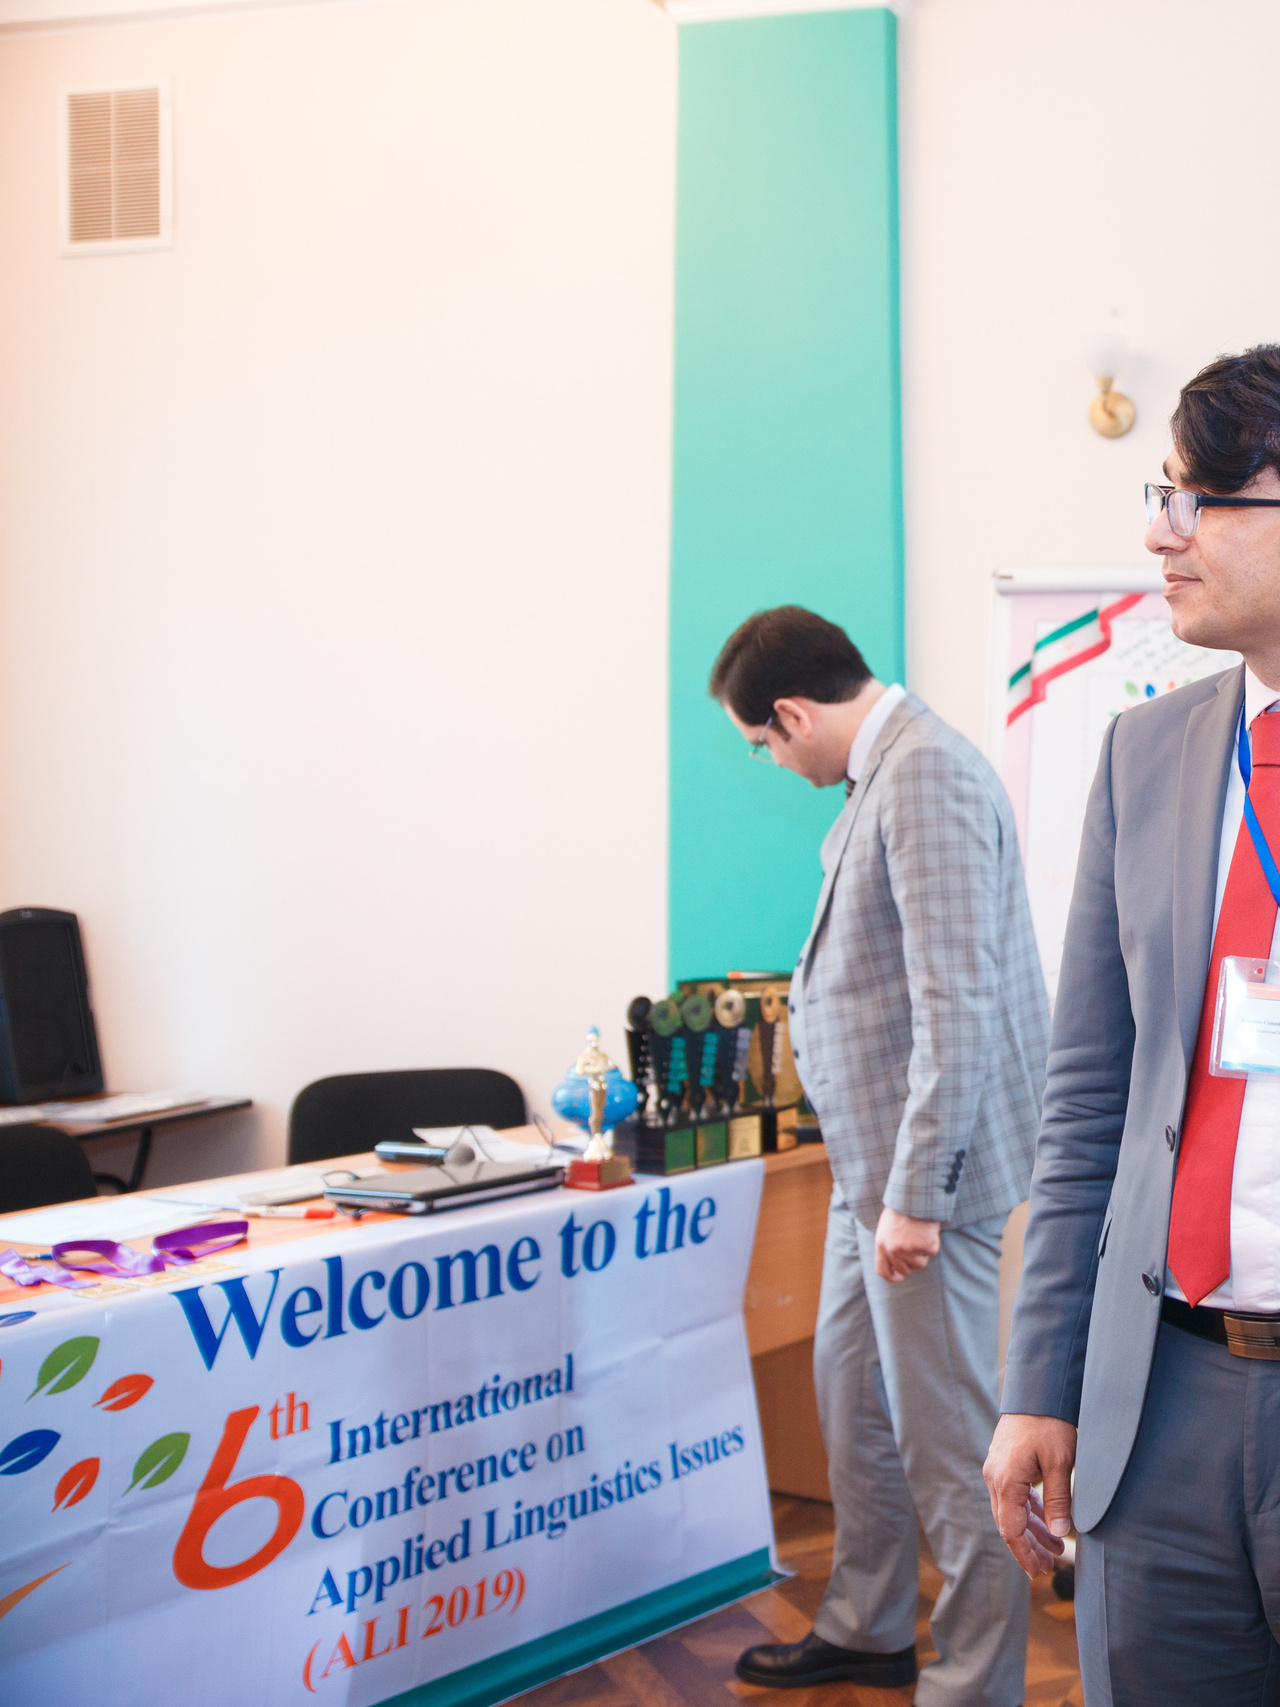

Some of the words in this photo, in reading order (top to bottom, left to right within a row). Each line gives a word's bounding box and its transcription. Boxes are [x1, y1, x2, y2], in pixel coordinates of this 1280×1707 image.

[170, 1235, 541, 1371] Welcome
[559, 1211, 616, 1279] to
[634, 1186, 716, 1260] the
[324, 1353, 575, 1465] International
[305, 1519, 472, 1616] Applied
[482, 1461, 664, 1550] Linguistics
[669, 1424, 746, 1482] Issues
[310, 1442, 537, 1540] Conference
[545, 1424, 586, 1463] on
[301, 1608, 411, 1694] (ALI
[422, 1566, 527, 1651] 2019)
